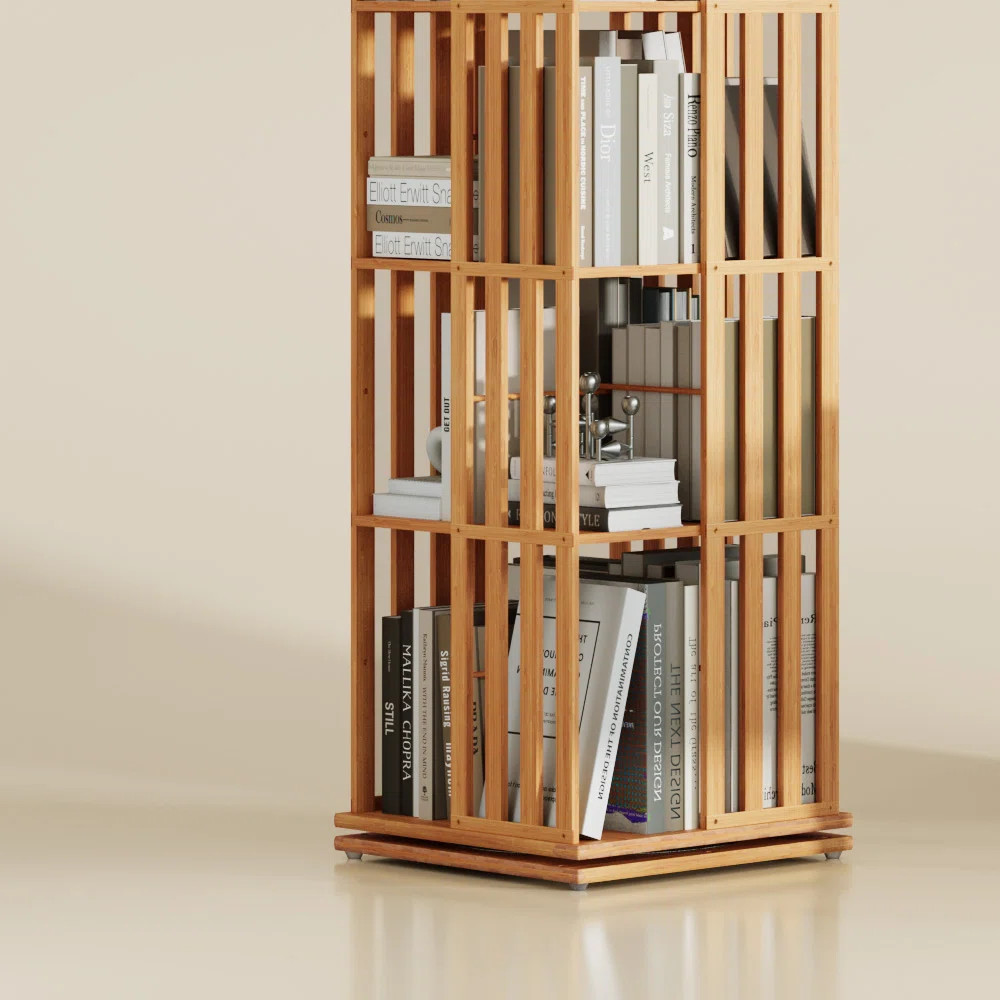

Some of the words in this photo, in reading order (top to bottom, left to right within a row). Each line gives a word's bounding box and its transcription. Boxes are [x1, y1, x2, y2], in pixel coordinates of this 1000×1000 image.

[663, 112, 674, 136] Siza
[688, 94, 700, 125] Renzo
[600, 124, 616, 162] Dior
[688, 128, 700, 158] Piano
[644, 152, 654, 184] West
[370, 182, 396, 202] Elliott
[400, 182, 428, 204] Erwitt
[375, 210, 402, 224] Cosmos
[376, 234, 400, 255] Elliott
[404, 235, 431, 256] Erwitt
[402, 644, 412, 712] MALLIKA
[440, 650, 450, 682] Sigrid
[384, 702, 394, 736] STILL
[442, 686, 450, 728] Rausing
[402, 720, 412, 781] CHOPRA
